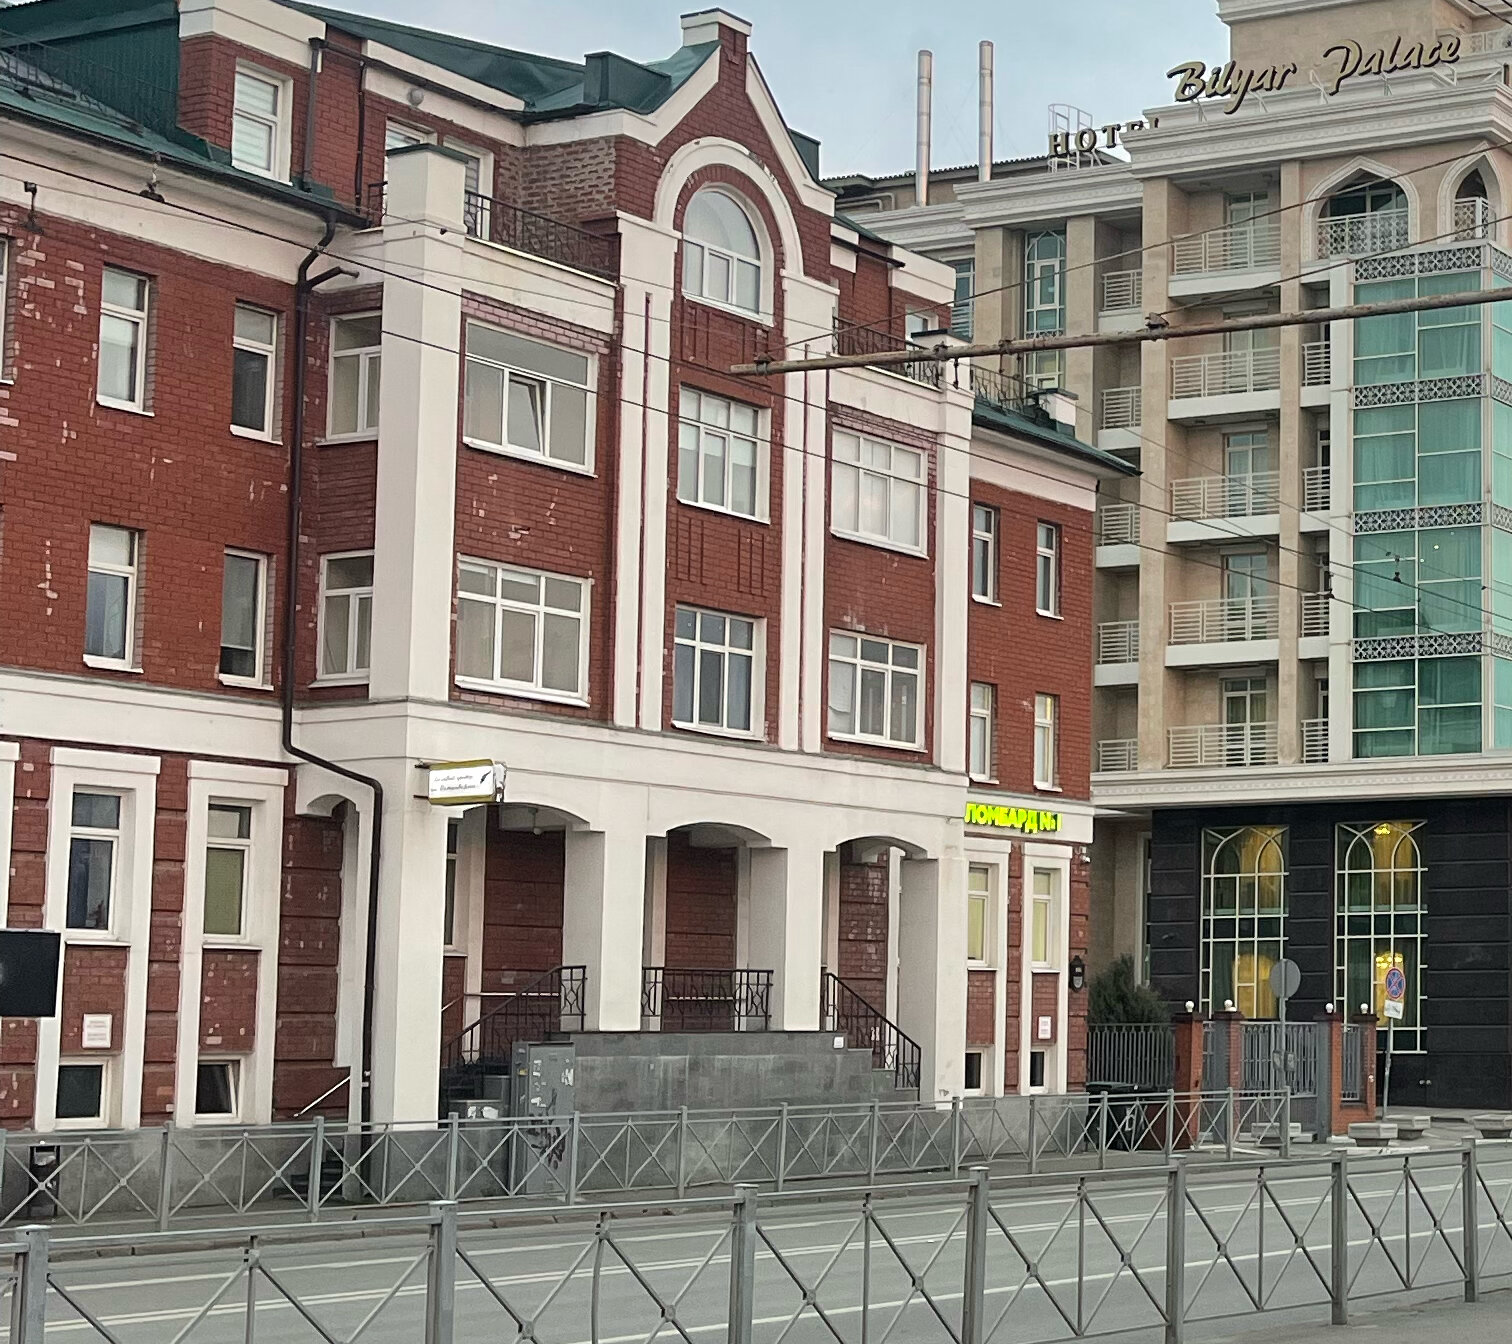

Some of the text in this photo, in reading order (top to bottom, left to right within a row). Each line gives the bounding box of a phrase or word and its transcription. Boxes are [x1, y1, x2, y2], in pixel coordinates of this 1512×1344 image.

[1166, 35, 1461, 114] Bilyar Palace
[964, 802, 1038, 833] ЛОМБАРД
